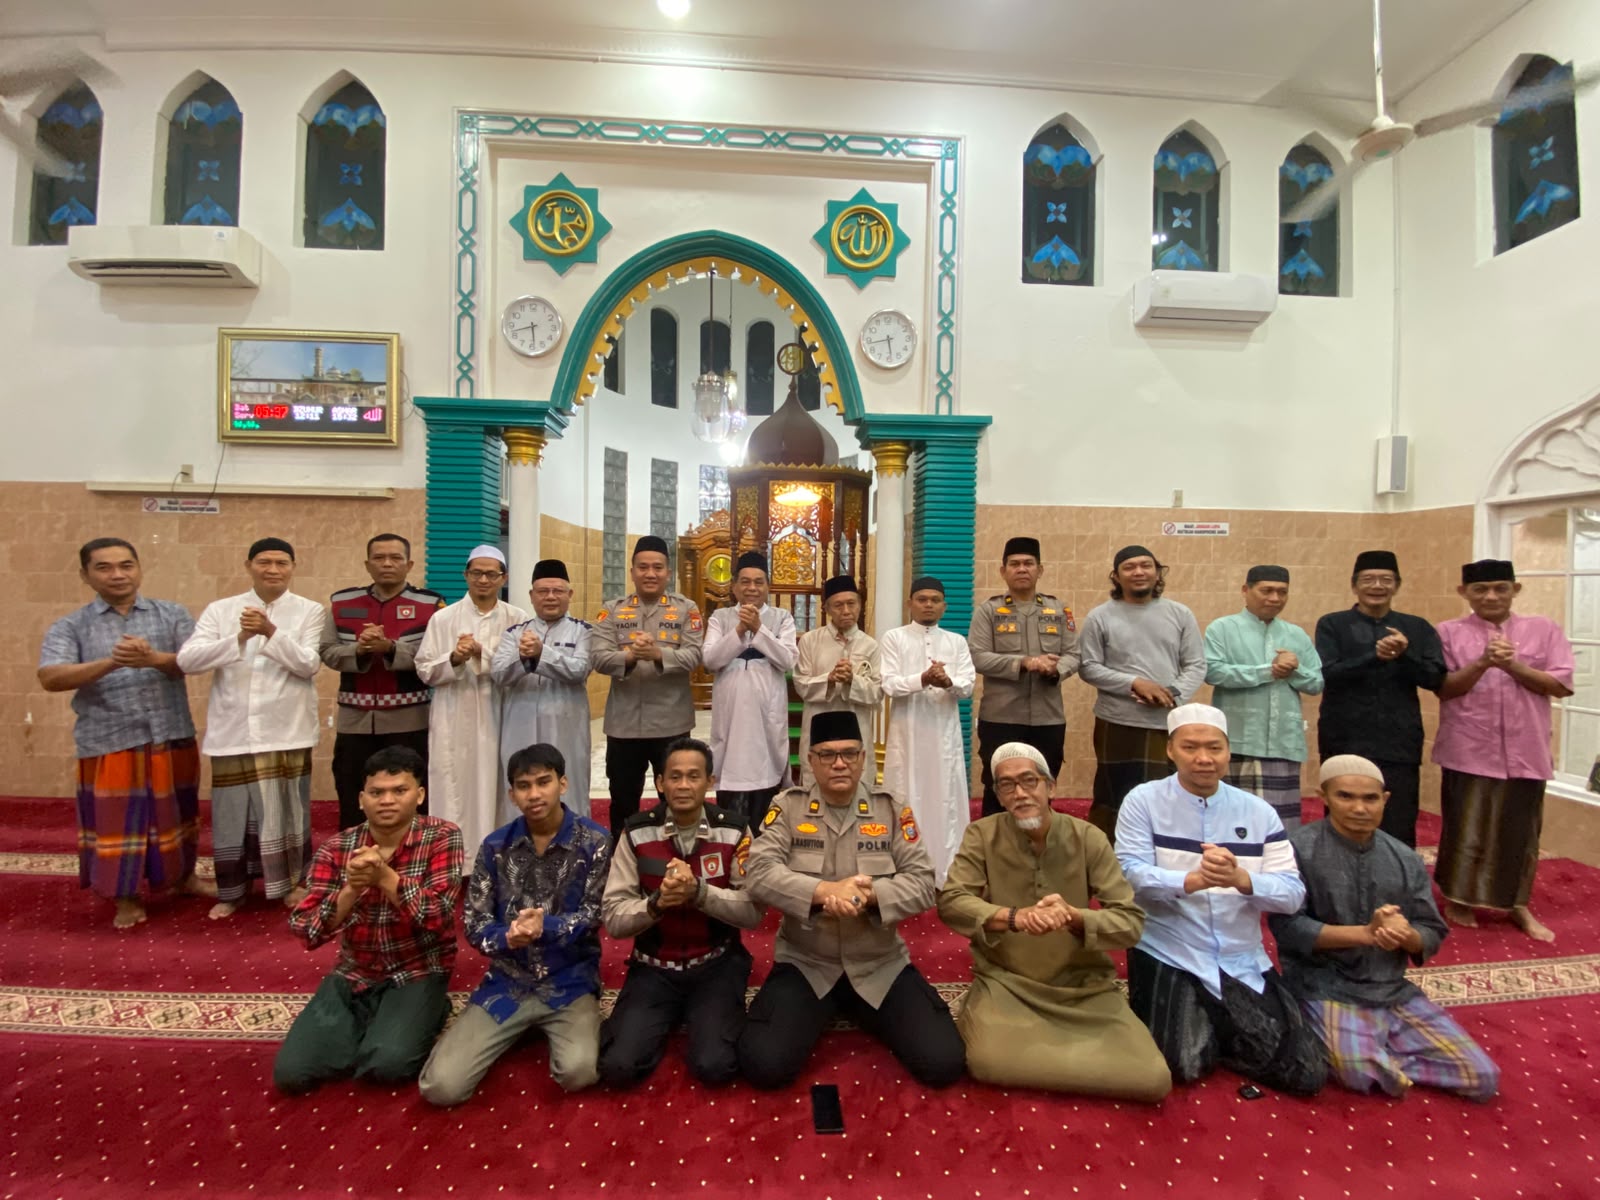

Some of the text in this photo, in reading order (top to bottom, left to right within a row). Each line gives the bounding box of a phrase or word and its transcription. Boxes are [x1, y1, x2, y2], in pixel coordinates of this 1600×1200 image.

[520, 304, 526, 313] 11
[529, 303, 538, 312] 12
[512, 312, 521, 320] 10
[883, 316, 892, 325] 12
[509, 321, 515, 330] 9
[551, 324, 557, 332] 3
[902, 325, 908, 333] 2
[519, 339, 526, 347] 7
[866, 336, 873, 344] 9
[905, 335, 911, 343] 3
[870, 346, 876, 354] 8
[1039, 615, 1061, 623] POLRI
[858, 841, 890, 850] POLRI
